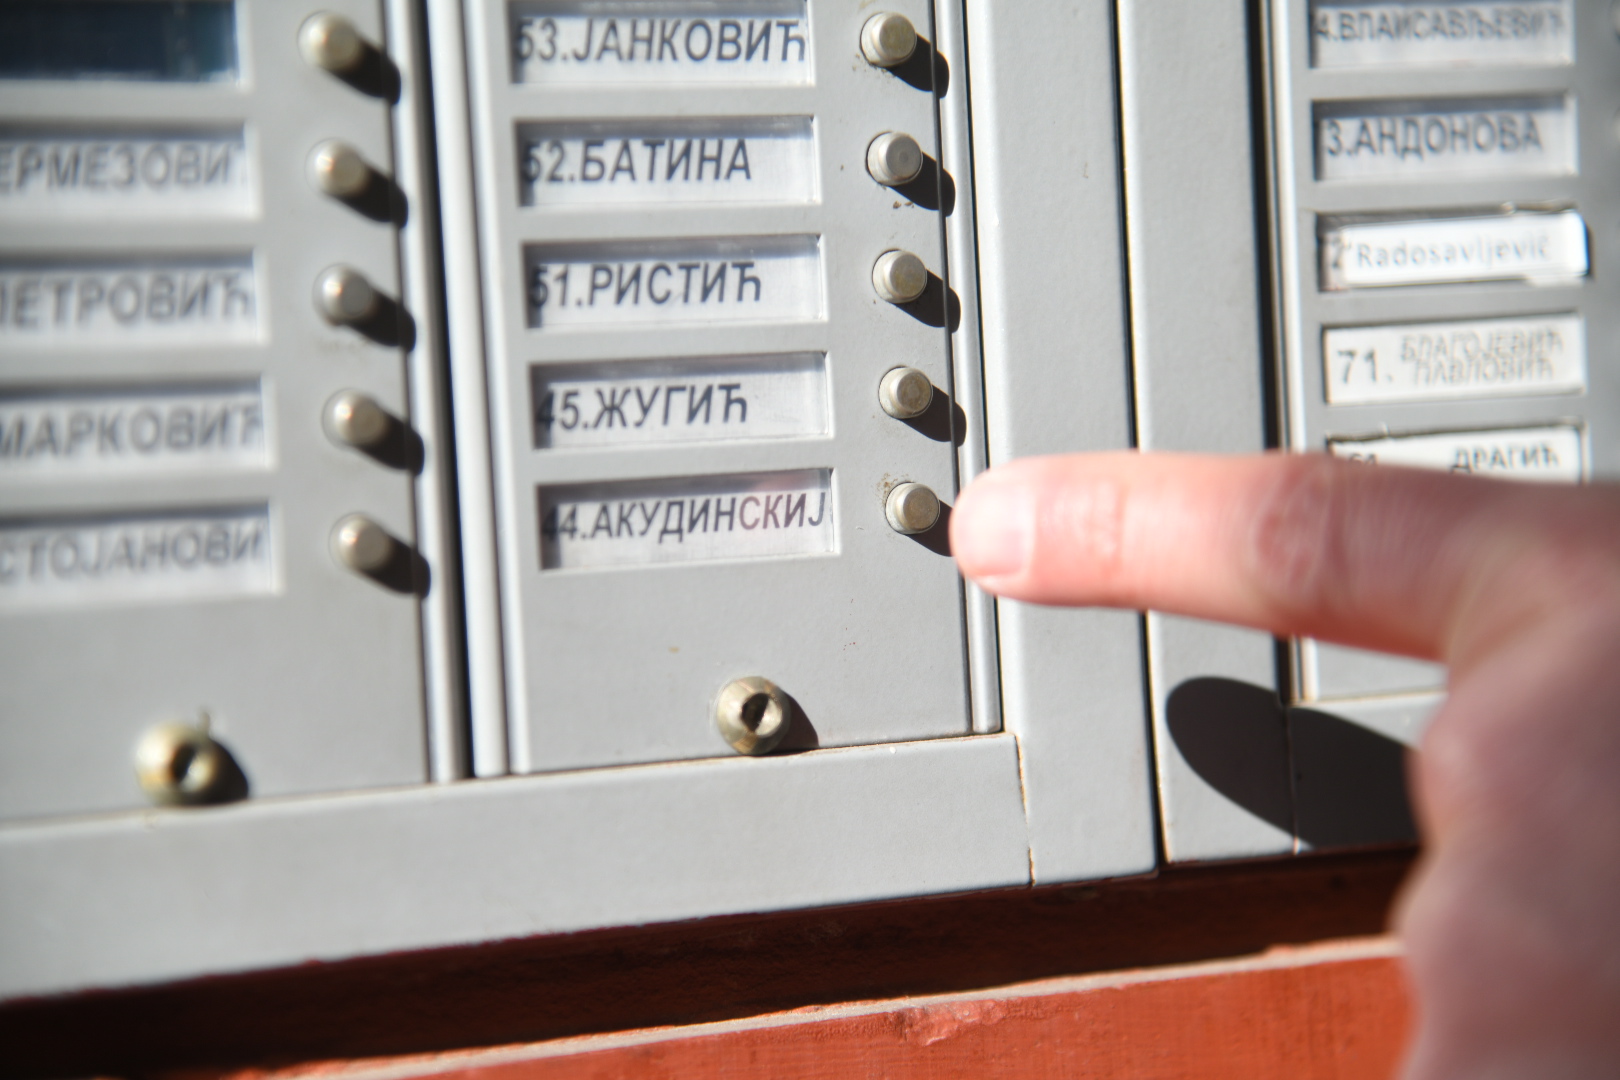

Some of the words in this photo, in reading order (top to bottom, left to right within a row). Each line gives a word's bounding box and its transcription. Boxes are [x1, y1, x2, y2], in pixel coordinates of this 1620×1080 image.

[522, 137, 752, 183] 52.БАТИНА
[1325, 114, 1543, 160] 3.АНДОНОВА
[530, 260, 762, 308] 51.РИСТИЋ
[1337, 348, 1394, 384] 71.
[534, 382, 749, 431] 45.ЖУГИЋ
[1450, 443, 1561, 475] ДРАГИЋ
